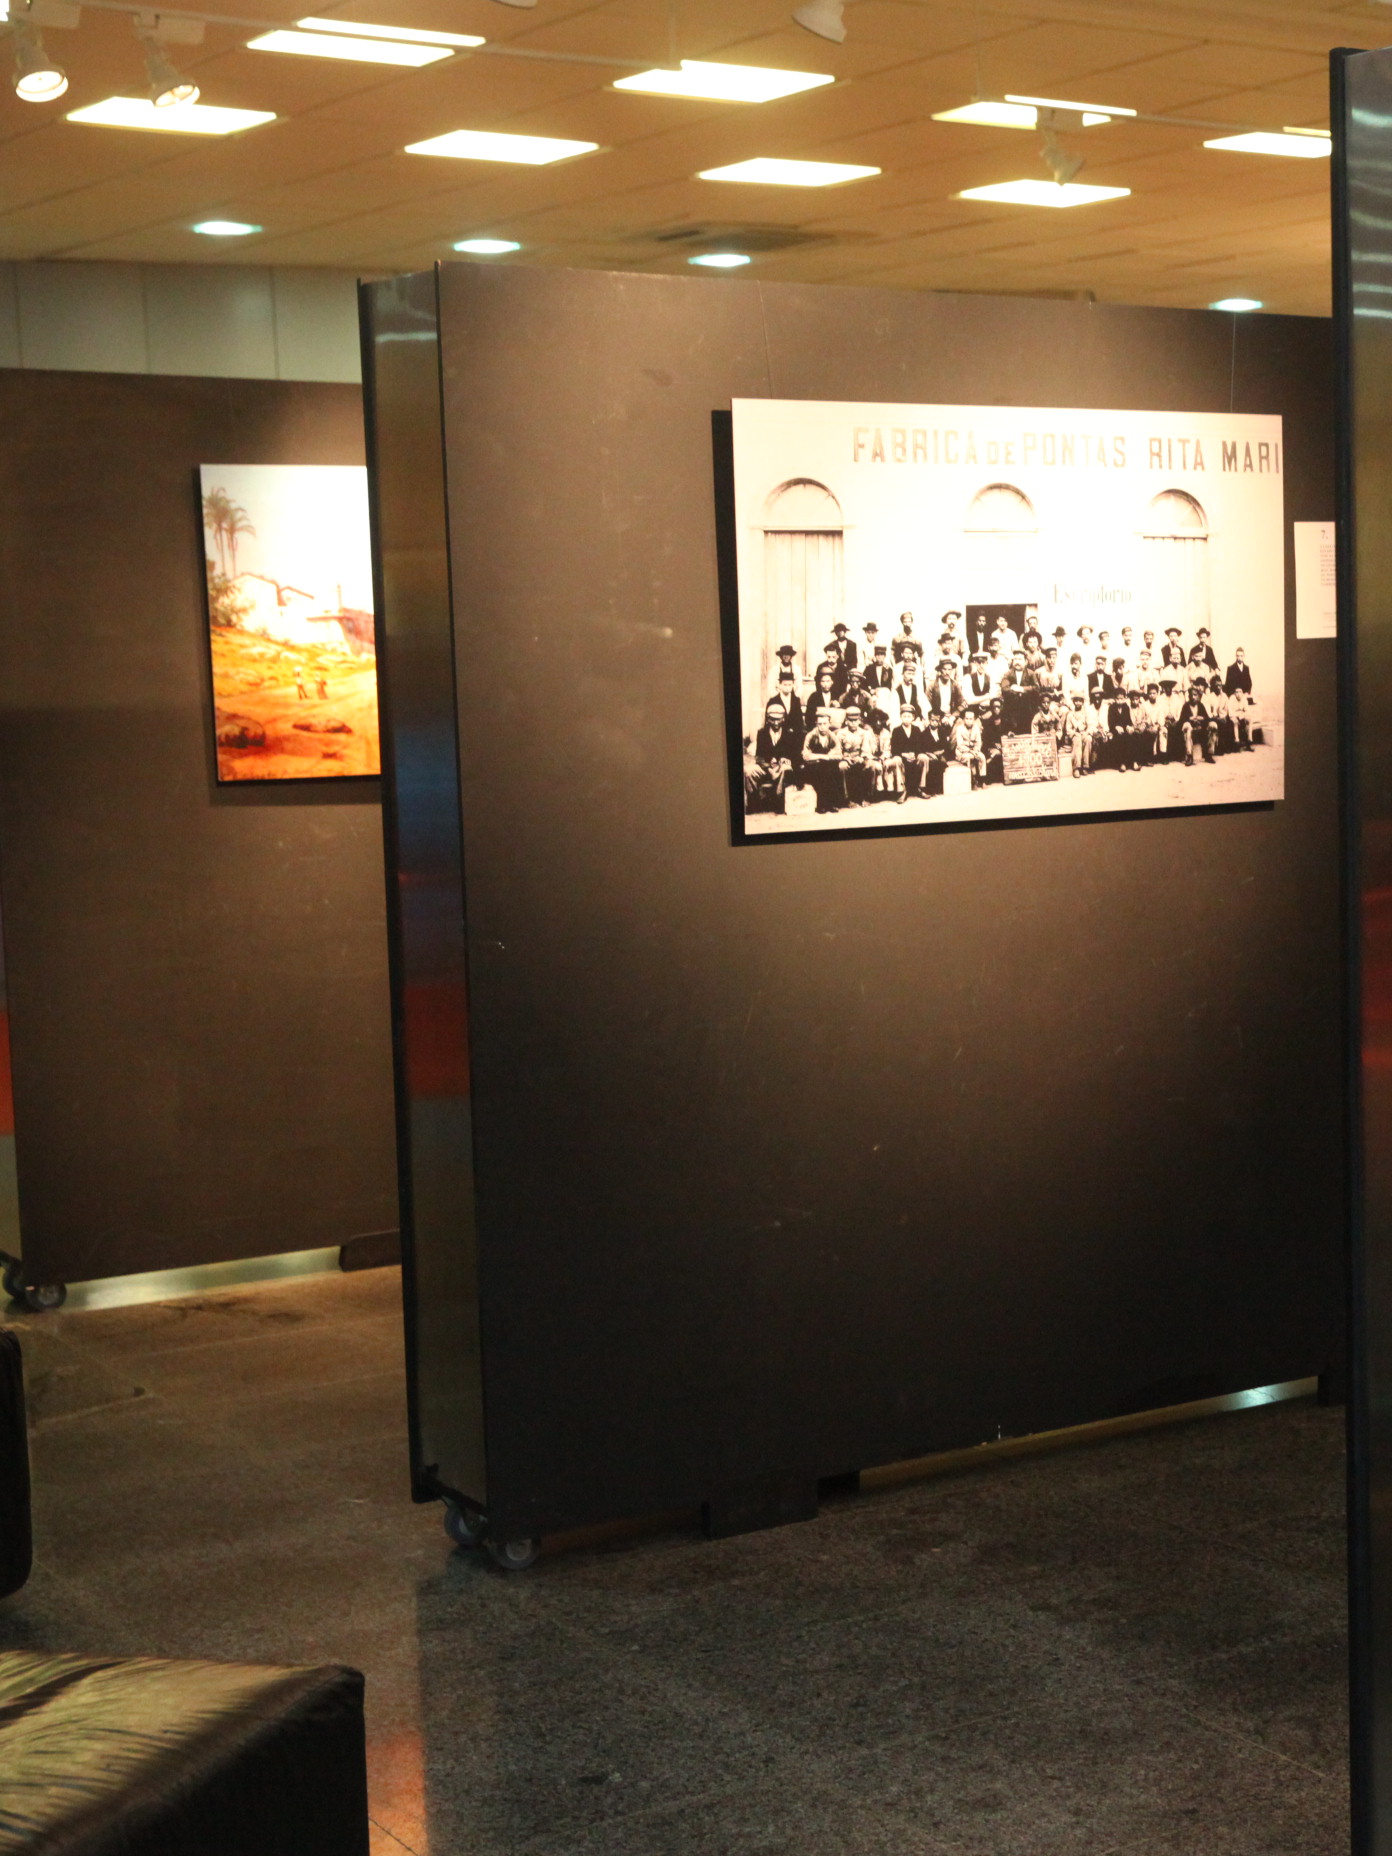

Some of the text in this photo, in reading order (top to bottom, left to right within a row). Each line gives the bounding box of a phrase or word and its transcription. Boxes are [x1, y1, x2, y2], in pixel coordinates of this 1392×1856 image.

[853, 426, 978, 465] FABRICA
[1022, 432, 1127, 468] PONTAS
[1148, 437, 1206, 472] RITA
[1221, 440, 1280, 474] MARI
